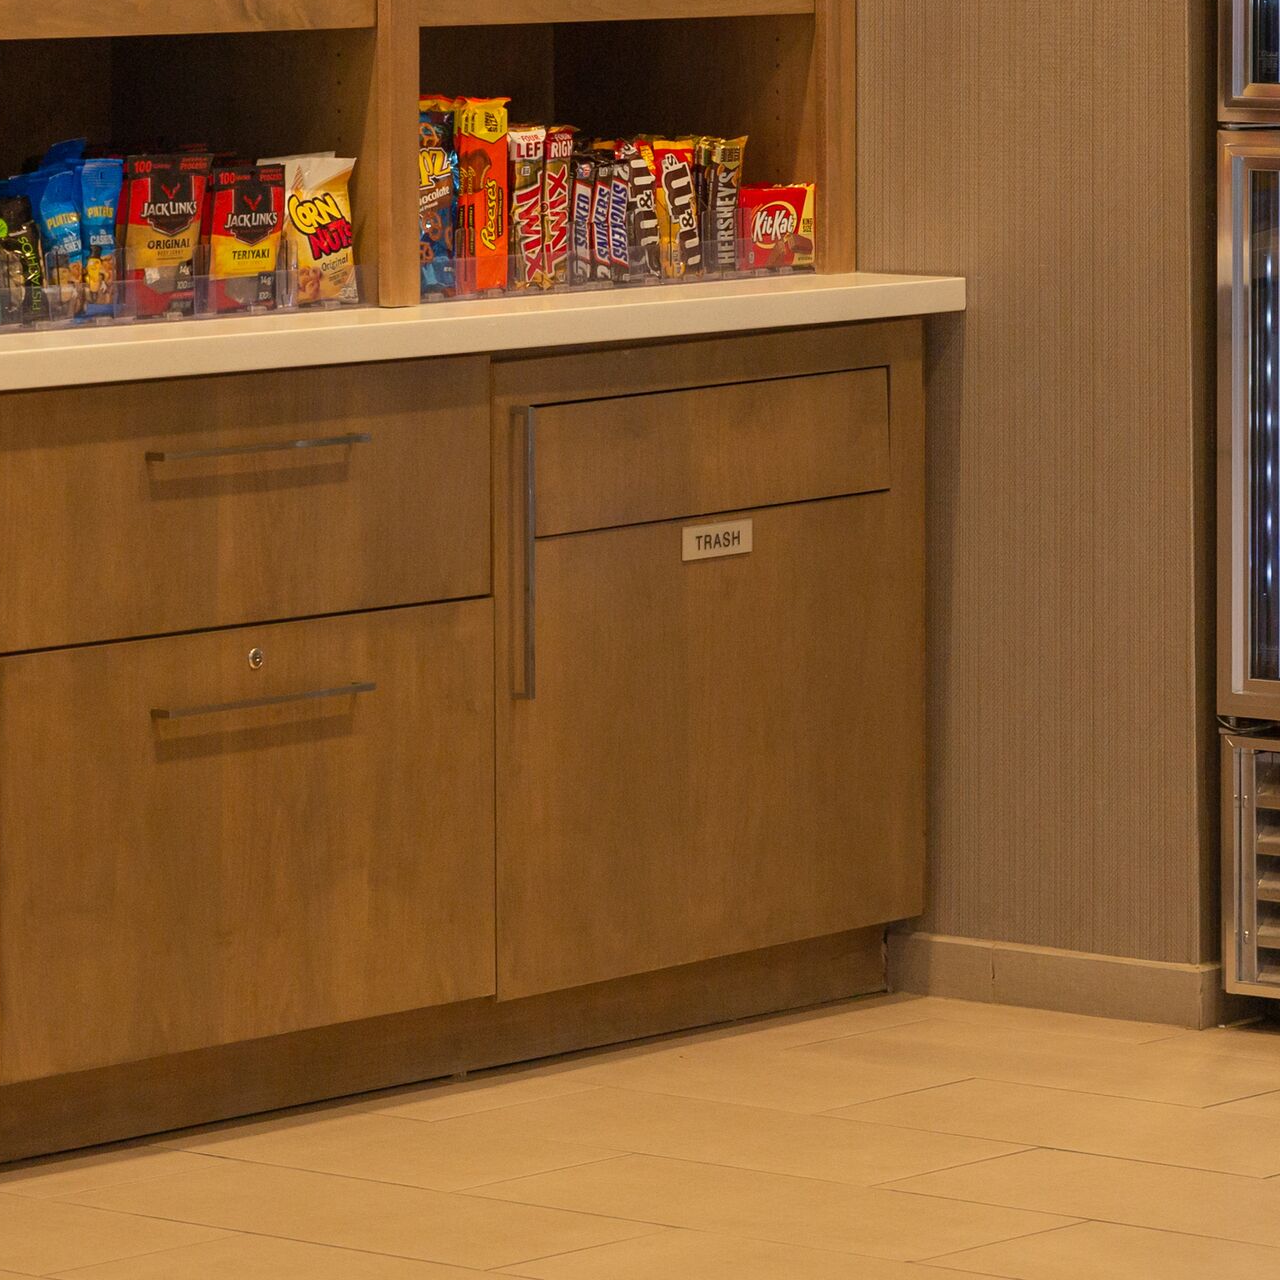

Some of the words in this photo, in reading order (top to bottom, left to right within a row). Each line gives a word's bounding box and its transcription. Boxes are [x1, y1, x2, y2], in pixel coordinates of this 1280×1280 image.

[521, 134, 539, 142] FOUR
[516, 142, 542, 158] LEF
[551, 140, 573, 158] RIGH
[134, 161, 153, 173] 100
[220, 172, 236, 184] 100
[141, 202, 170, 218] JACK
[169, 200, 197, 215] LINK'S
[288, 193, 342, 235] CORN
[480, 178, 497, 250] Reese's
[717, 171, 736, 263] HERSHEY'S
[224, 213, 252, 229] JACK
[251, 212, 278, 227] LINK'S
[515, 171, 542, 282] TWIX
[545, 164, 569, 276] TWIX
[596, 187, 610, 261] SNICKERS
[612, 182, 629, 262] SNICKERS
[147, 238, 190, 250] ORIGINAL
[309, 218, 352, 260] NUTS
[232, 248, 270, 261] TERIYAKI
[321, 253, 348, 272] Original
[18, 236, 41, 311] PISTACHIOS
[696, 531, 740, 551] TRASH
